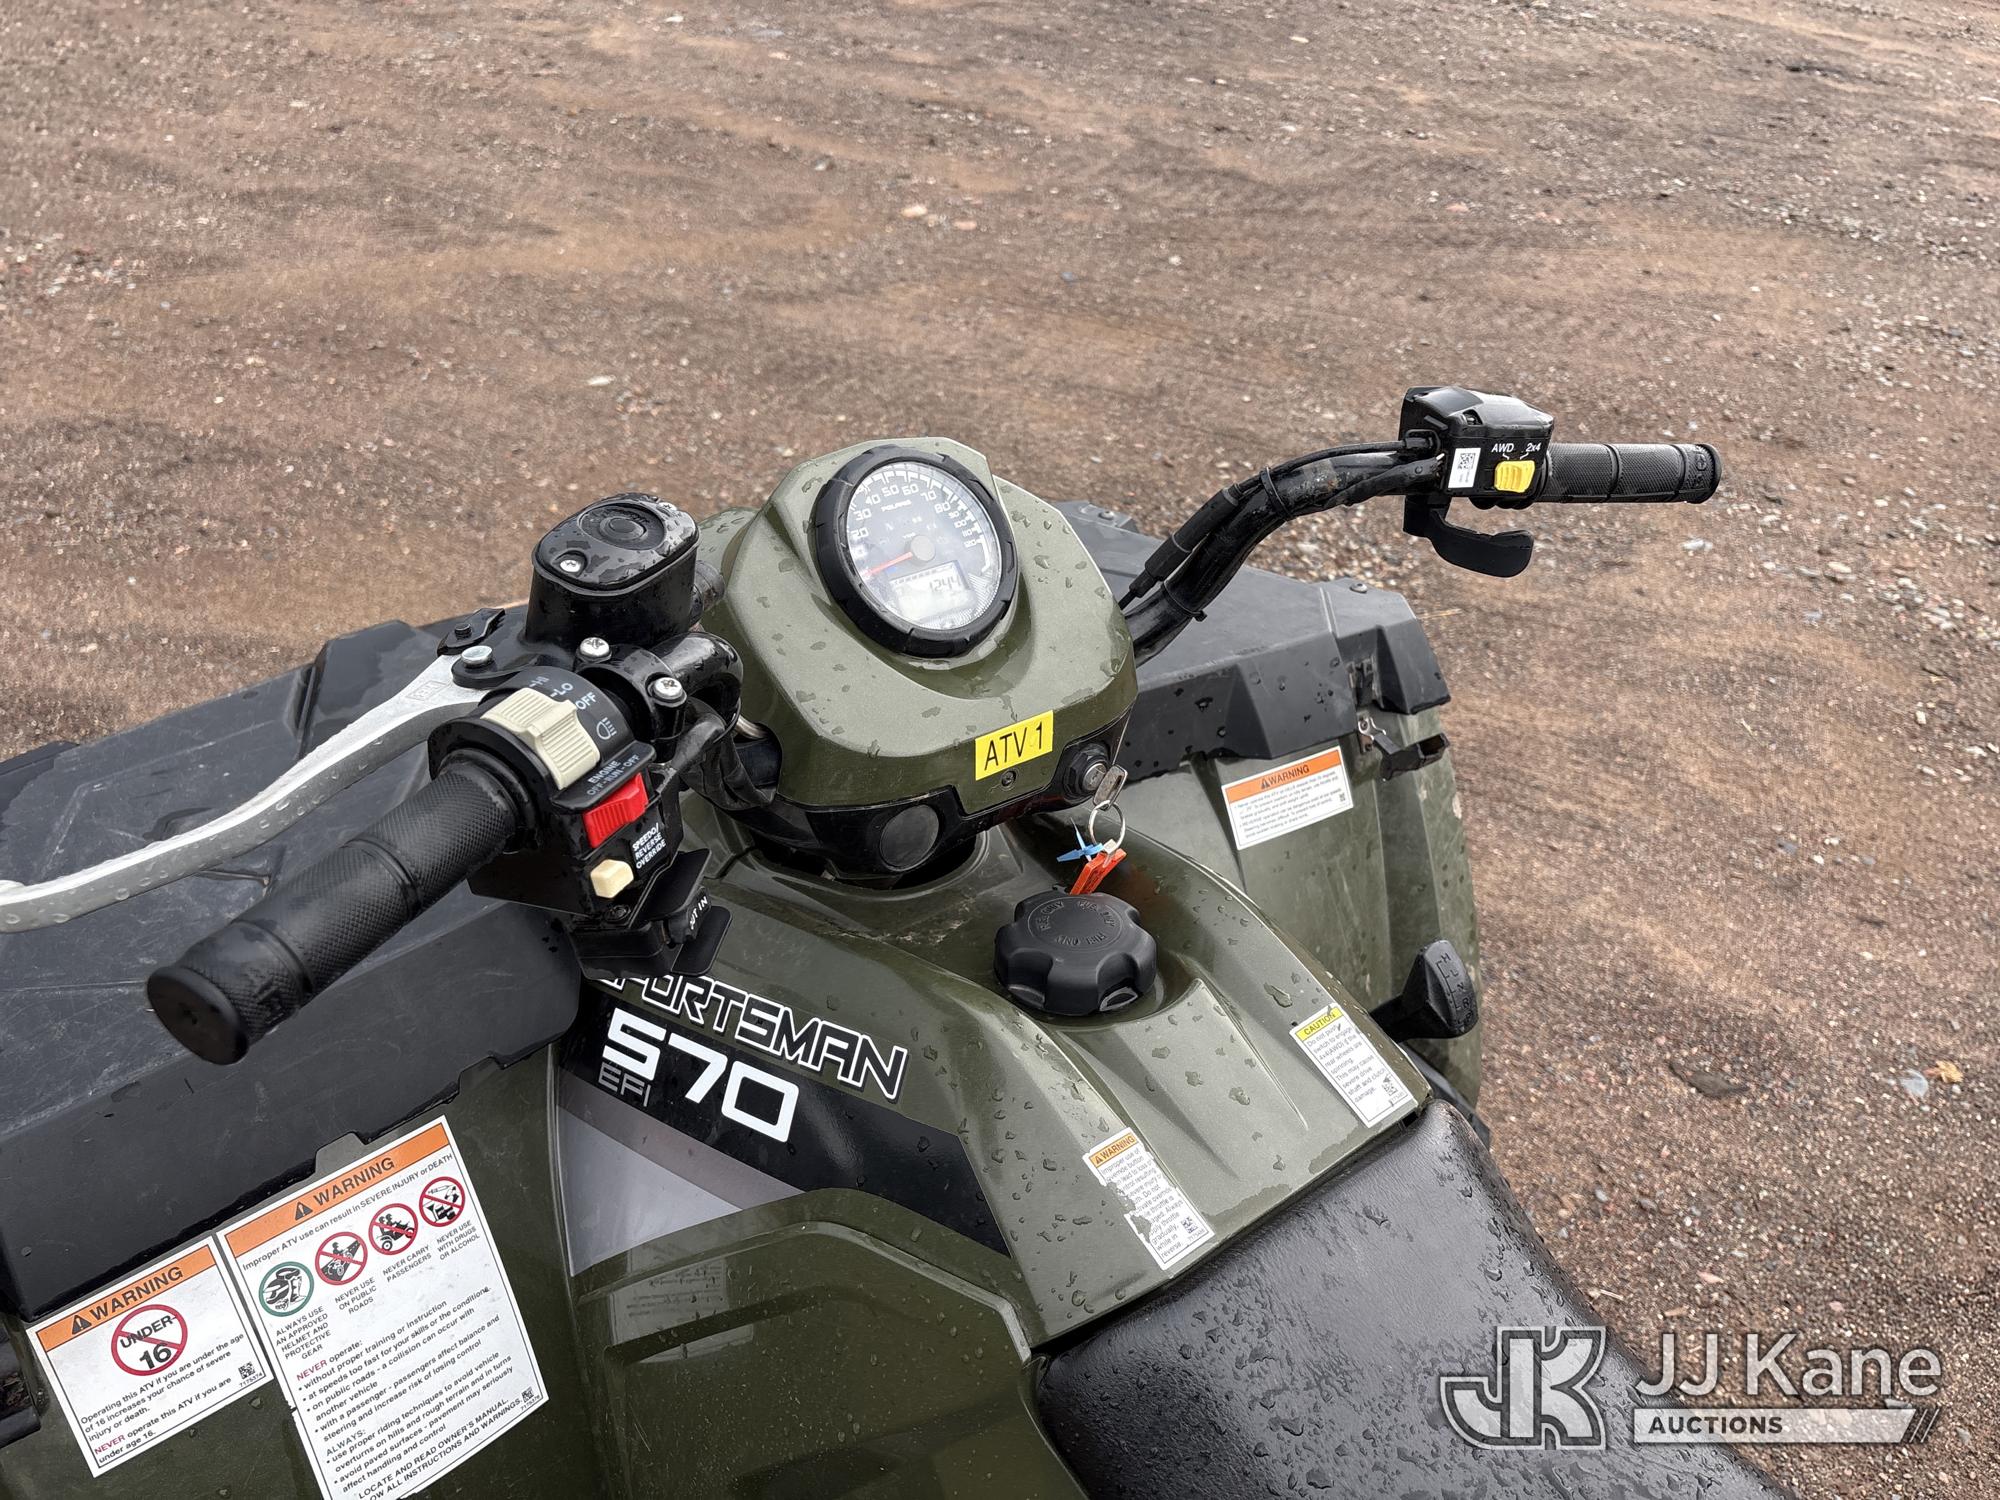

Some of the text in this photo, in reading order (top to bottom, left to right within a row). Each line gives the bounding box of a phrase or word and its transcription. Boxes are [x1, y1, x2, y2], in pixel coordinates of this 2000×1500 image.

[1491, 443, 1514, 453] AWD
[1526, 442, 1541, 452] 2x4
[865, 494, 880, 505] 40
[881, 484, 899, 497] 50
[902, 483, 919, 495] 60
[920, 490, 936, 501] 70
[853, 508, 871, 521] 30
[934, 501, 950, 513] 80
[575, 691, 596, 710] OFF
[984, 721, 1042, 771] ATV 1
[588, 760, 621, 784] ENGINE
[1269, 764, 1310, 785] WARNING
[632, 822, 659, 852] SPEEDO/
[634, 832, 662, 860] REVERSE
[636, 839, 667, 869] OVERRIDE
[698, 896, 708, 911] IN
[1440, 952, 1451, 964] H
[599, 974, 908, 1100] ORTSMAN
[1304, 1013, 1336, 1035] CAUTION
[598, 1062, 651, 1107] EFI
[602, 1007, 800, 1143] 570
[1101, 1135, 1135, 1160] WARNING
[313, 1157, 395, 1207] WARNING
[242, 1153, 452, 1270] Improper ATV use can result in SEVERE INJURY or DEATH
[436, 1219, 471, 1244] NEVER USE
[436, 1225, 476, 1252] WITH DRUGS
[439, 1233, 480, 1260] OR ALCOHOL
[382, 1244, 428, 1275] NEVER CARRY
[386, 1252, 431, 1282] PASSENGERS
[89, 1266, 183, 1321] WARNING
[334, 1276, 375, 1303] NEVER USE
[338, 1285, 376, 1310] ON PUBLIC
[348, 1296, 373, 1314] ROADS
[276, 1305, 323, 1336] ALWAYS USE
[276, 1312, 327, 1346] AN APPROVED
[281, 1322, 328, 1352] HELMET AND
[284, 1329, 331, 1359] PROTECTIVE
[301, 1343, 322, 1359] GEAR
[303, 1300, 447, 1389] without proper training or instruction
[139, 1342, 172, 1370] 16
[296, 1339, 362, 1380] NEVER operate:
[308, 1390, 317, 1400] at
[318, 1373, 348, 1394] speeds
[348, 1364, 362, 1375] too
[363, 1353, 379, 1366] fast
[380, 1346, 391, 1357] for
[392, 1335, 409, 1351] your
[410, 1324, 429, 1338] skills
[429, 1318, 437, 1326] or
[438, 1310, 451, 1320] the
[80, 1333, 243, 1424] Operating this ATV if you are under the age
[84, 1351, 230, 1432] of 16 increases your chance of severe
[93, 1377, 231, 1454] NEVER operate this ATV if you are
[331, 1352, 498, 1461] use proper riding techniques to avoid vehicle
[88, 1407, 150, 1441] injury or death.
[98, 1429, 155, 1463] under age 16.
[326, 1429, 365, 1456] ALWAYS:
[358, 1473, 393, 1498] LOCATE
[395, 1461, 412, 1477] AND
[413, 1446, 436, 1464] READ
[437, 1420, 474, 1448] OWNER'S
[474, 1399, 508, 1423] MANUAL.
[386, 1479, 402, 1491] ALL
[403, 1439, 462, 1480] INSTRUCTIONS
[463, 1427, 479, 1442] AND
